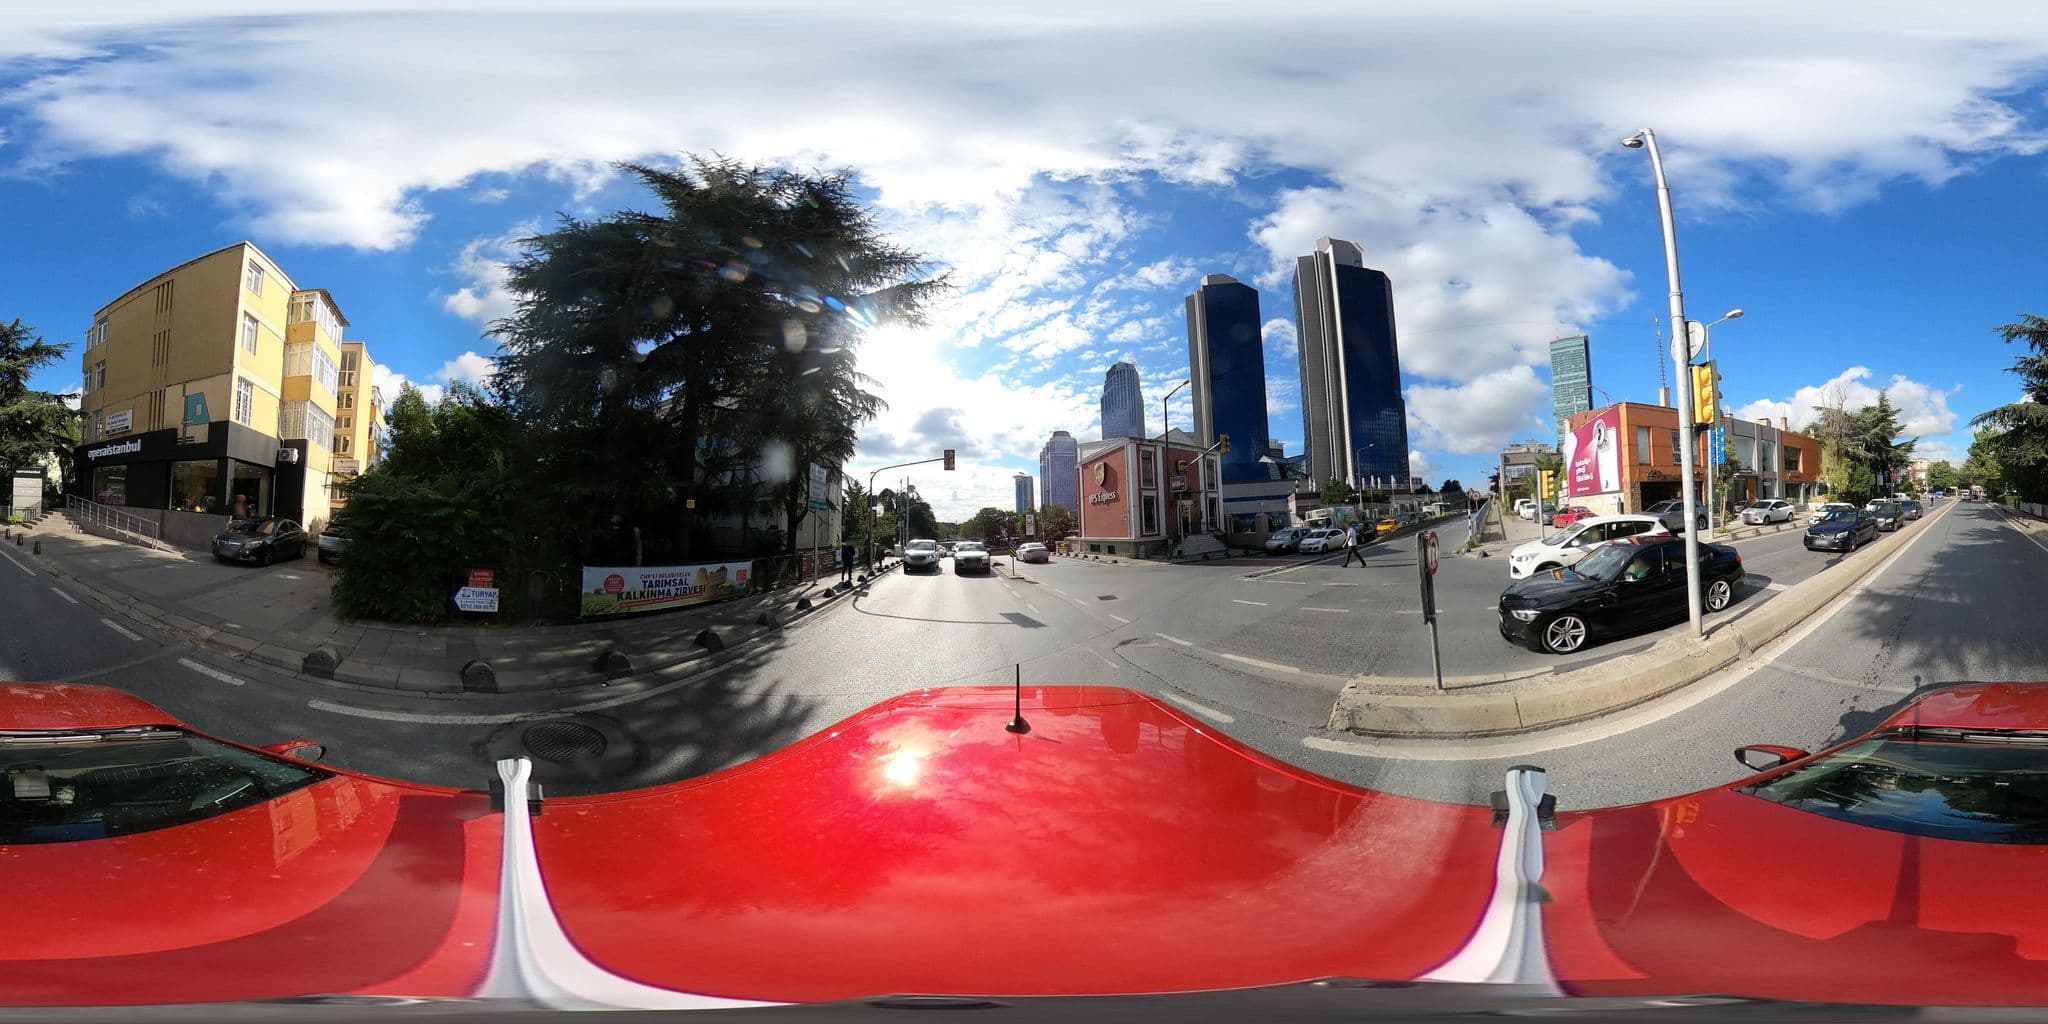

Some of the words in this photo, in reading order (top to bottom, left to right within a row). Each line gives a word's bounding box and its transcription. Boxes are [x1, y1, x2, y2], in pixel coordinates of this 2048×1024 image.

[88, 439, 141, 460] operaistanbul
[642, 578, 689, 589] TARIMSAL
[617, 588, 672, 601] KALKINMA
